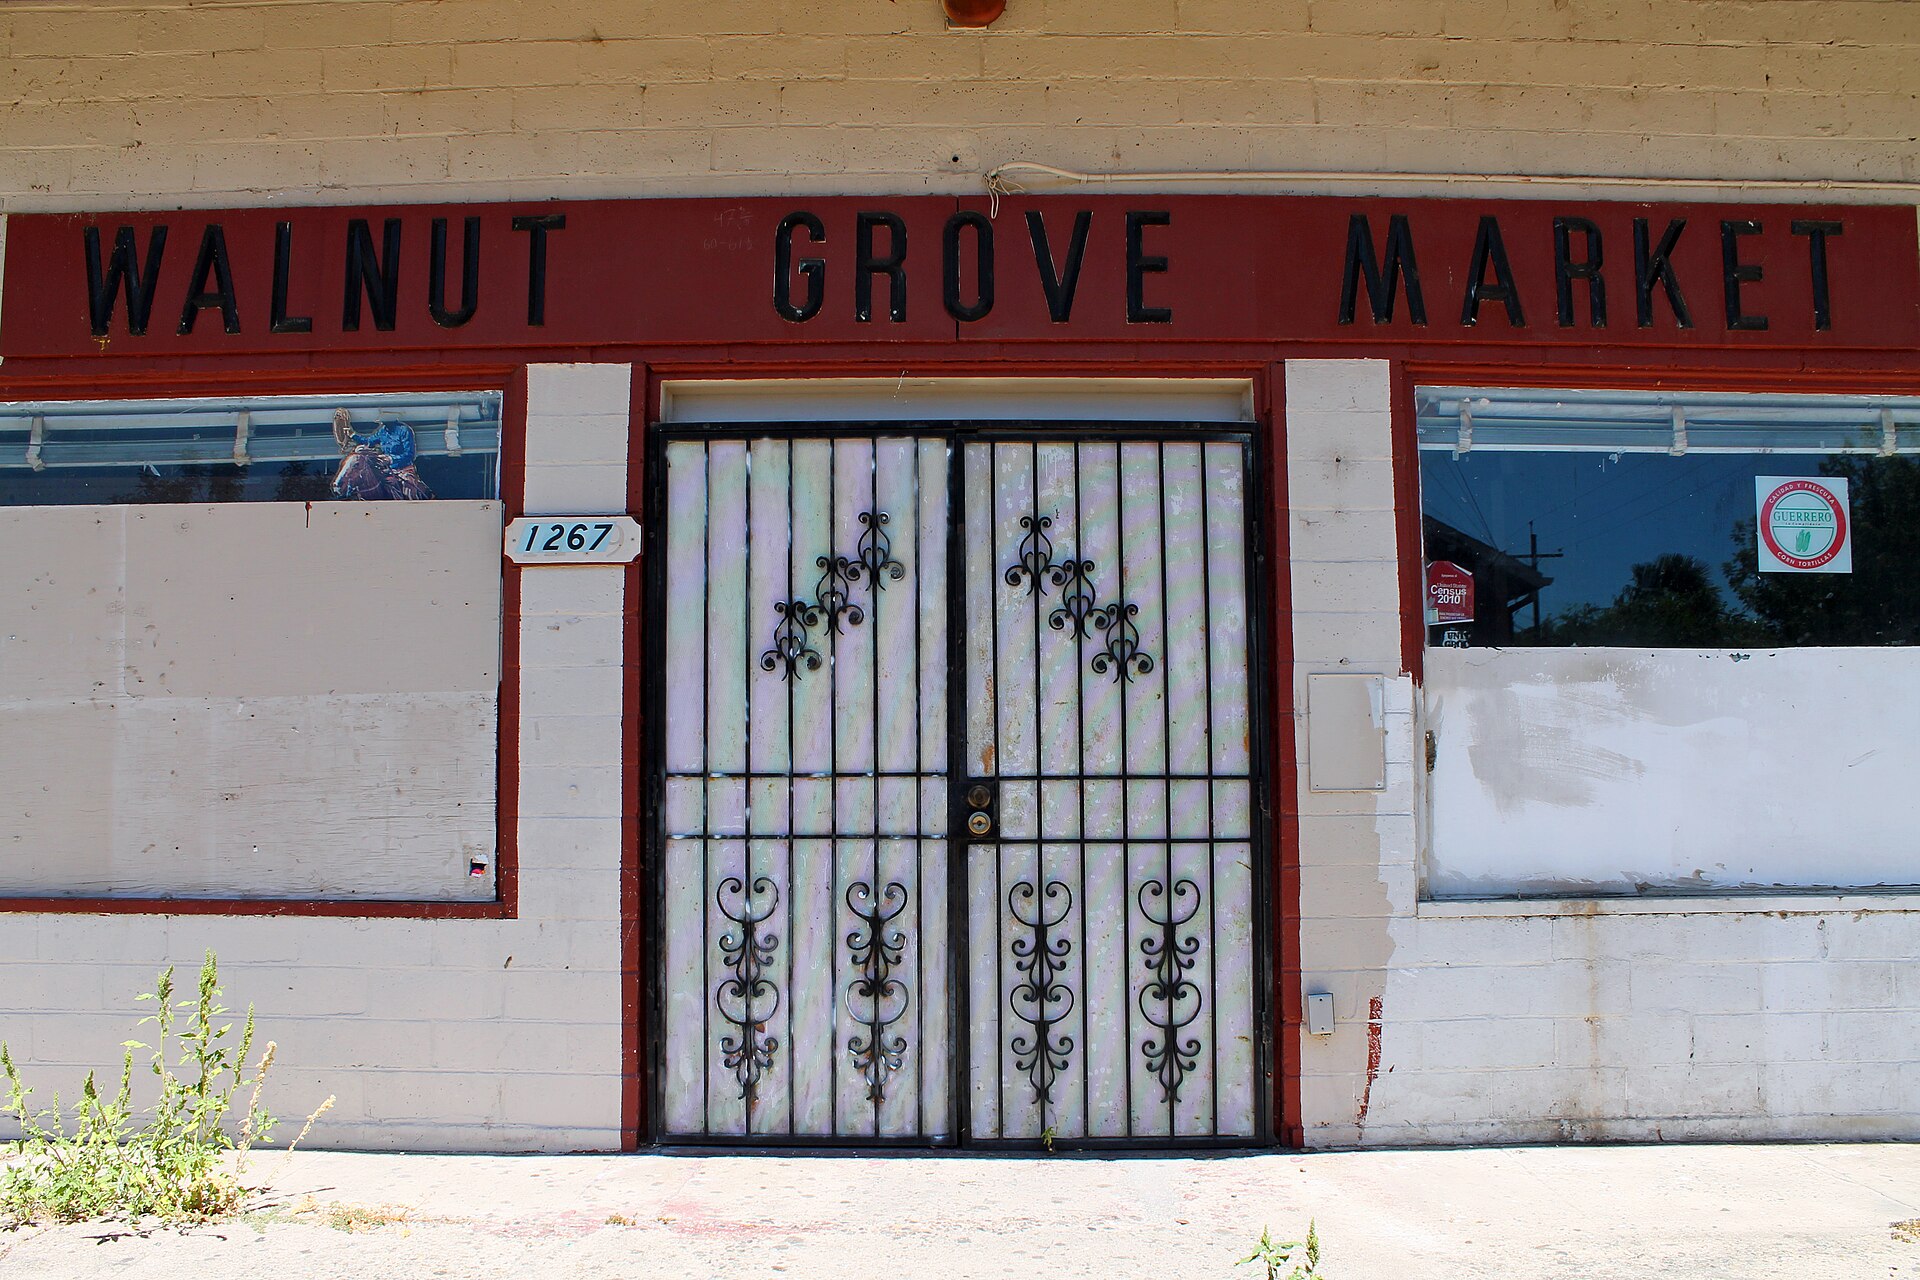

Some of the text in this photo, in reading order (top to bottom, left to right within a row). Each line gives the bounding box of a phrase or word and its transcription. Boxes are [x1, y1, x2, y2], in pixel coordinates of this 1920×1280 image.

[83, 210, 1843, 337] WALNUT GROVE MARKET
[1769, 484, 1794, 504] CALIDAD
[1804, 483, 1835, 504] FRESCURA
[1773, 511, 1832, 522] GUERRERO
[525, 523, 614, 552] 1267
[1777, 551, 1832, 567] CORN TORTILLAS
[1430, 584, 1467, 596] Census
[1437, 594, 1461, 604] 2010
